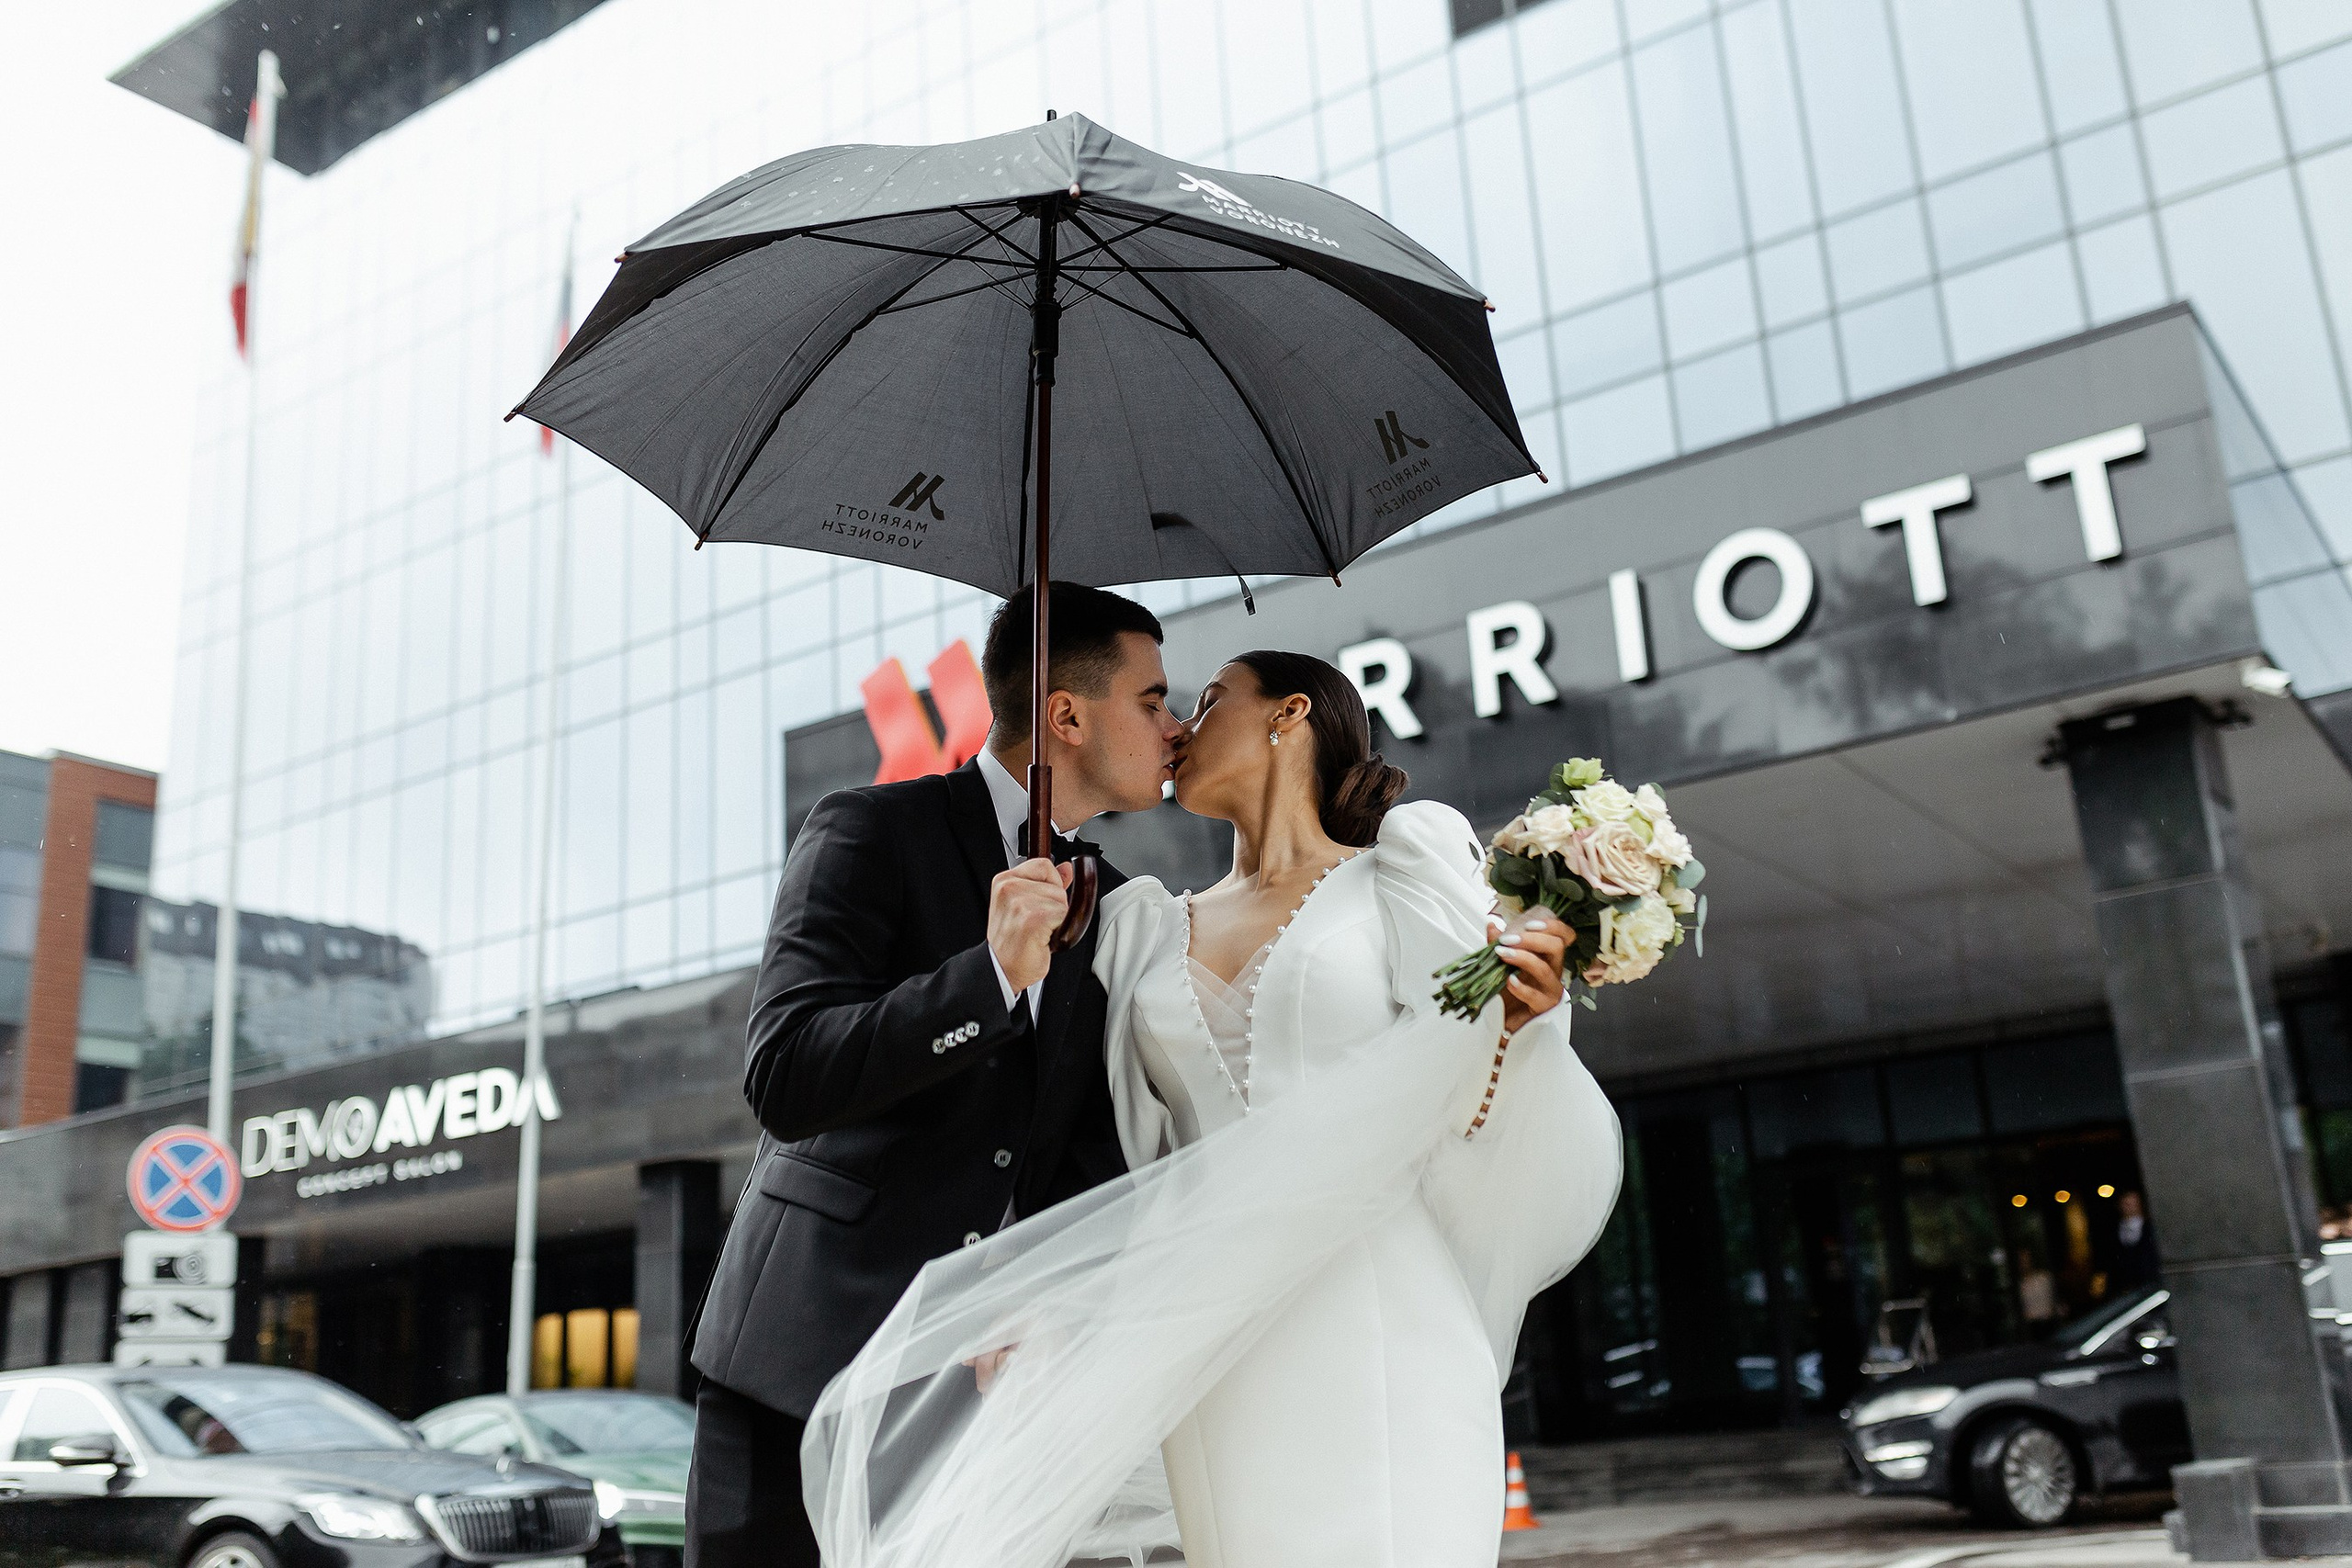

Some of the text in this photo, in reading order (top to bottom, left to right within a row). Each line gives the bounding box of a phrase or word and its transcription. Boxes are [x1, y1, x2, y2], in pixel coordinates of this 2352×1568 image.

[1202, 194, 1319, 235] MARRIOTT
[1209, 204, 1340, 249] VORONEZH
[1337, 422, 2147, 740] RRIOTT
